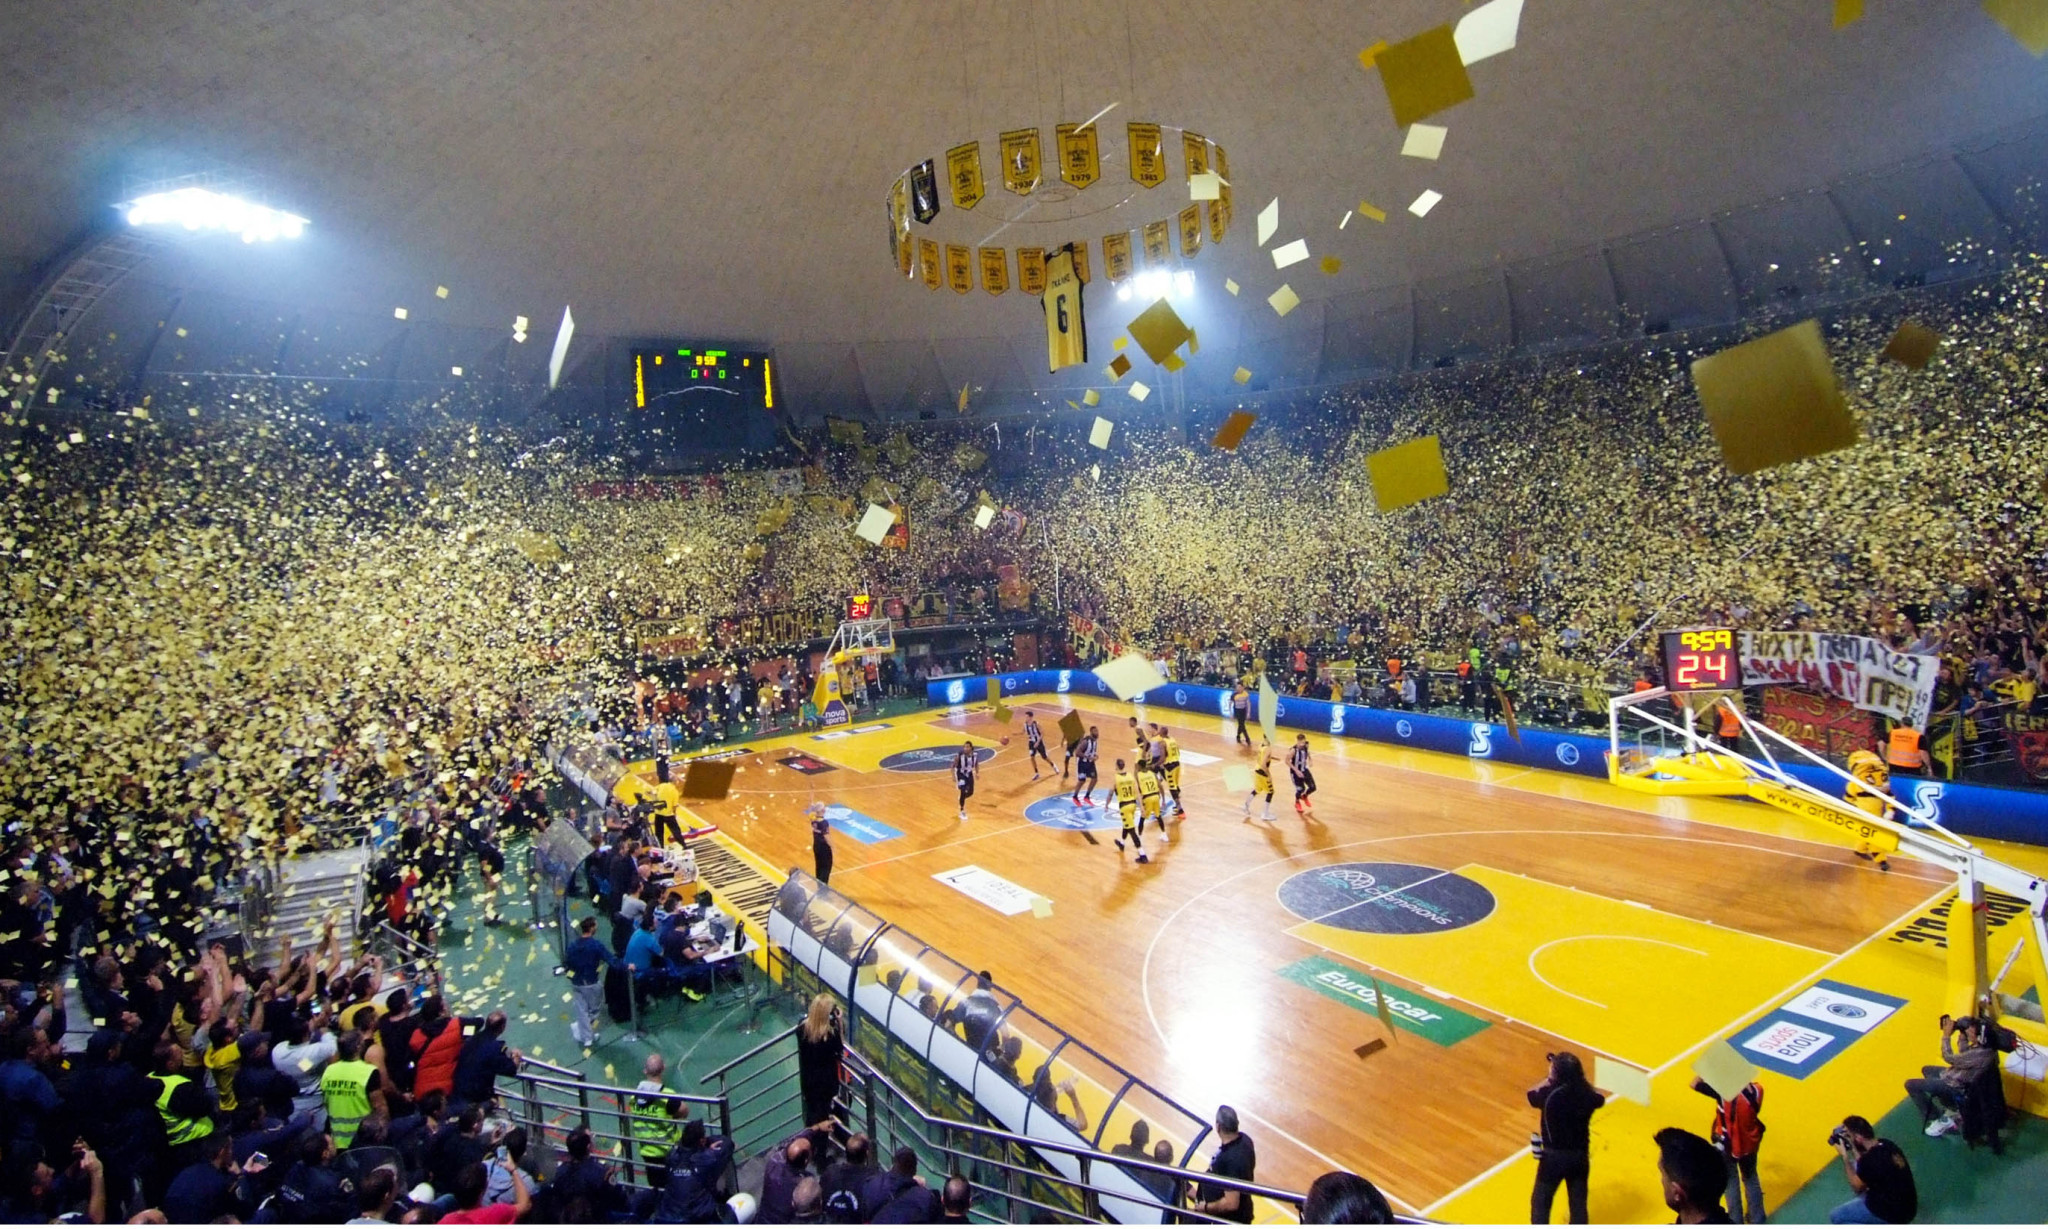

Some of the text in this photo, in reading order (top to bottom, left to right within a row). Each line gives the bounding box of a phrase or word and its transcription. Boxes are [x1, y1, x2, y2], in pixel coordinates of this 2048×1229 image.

[1071, 174, 1091, 182] 1979
[959, 193, 977, 205] 2004
[1056, 293, 1068, 334] 6
[691, 369, 699, 379] 0
[718, 370, 726, 379] 0
[852, 604, 869, 617] 24
[1681, 629, 1732, 652] 9:59
[1677, 654, 1727, 684] 24
[825, 709, 846, 719] nova
[825, 717, 847, 725] sports
[1122, 786, 1133, 798] 34
[1145, 781, 1156, 792] 12
[1765, 790, 1878, 839] www.arisbc.gr
[1758, 1026, 1798, 1050] sports
[1777, 1032, 1821, 1057] nova
[326, 1080, 357, 1089] SUPER
